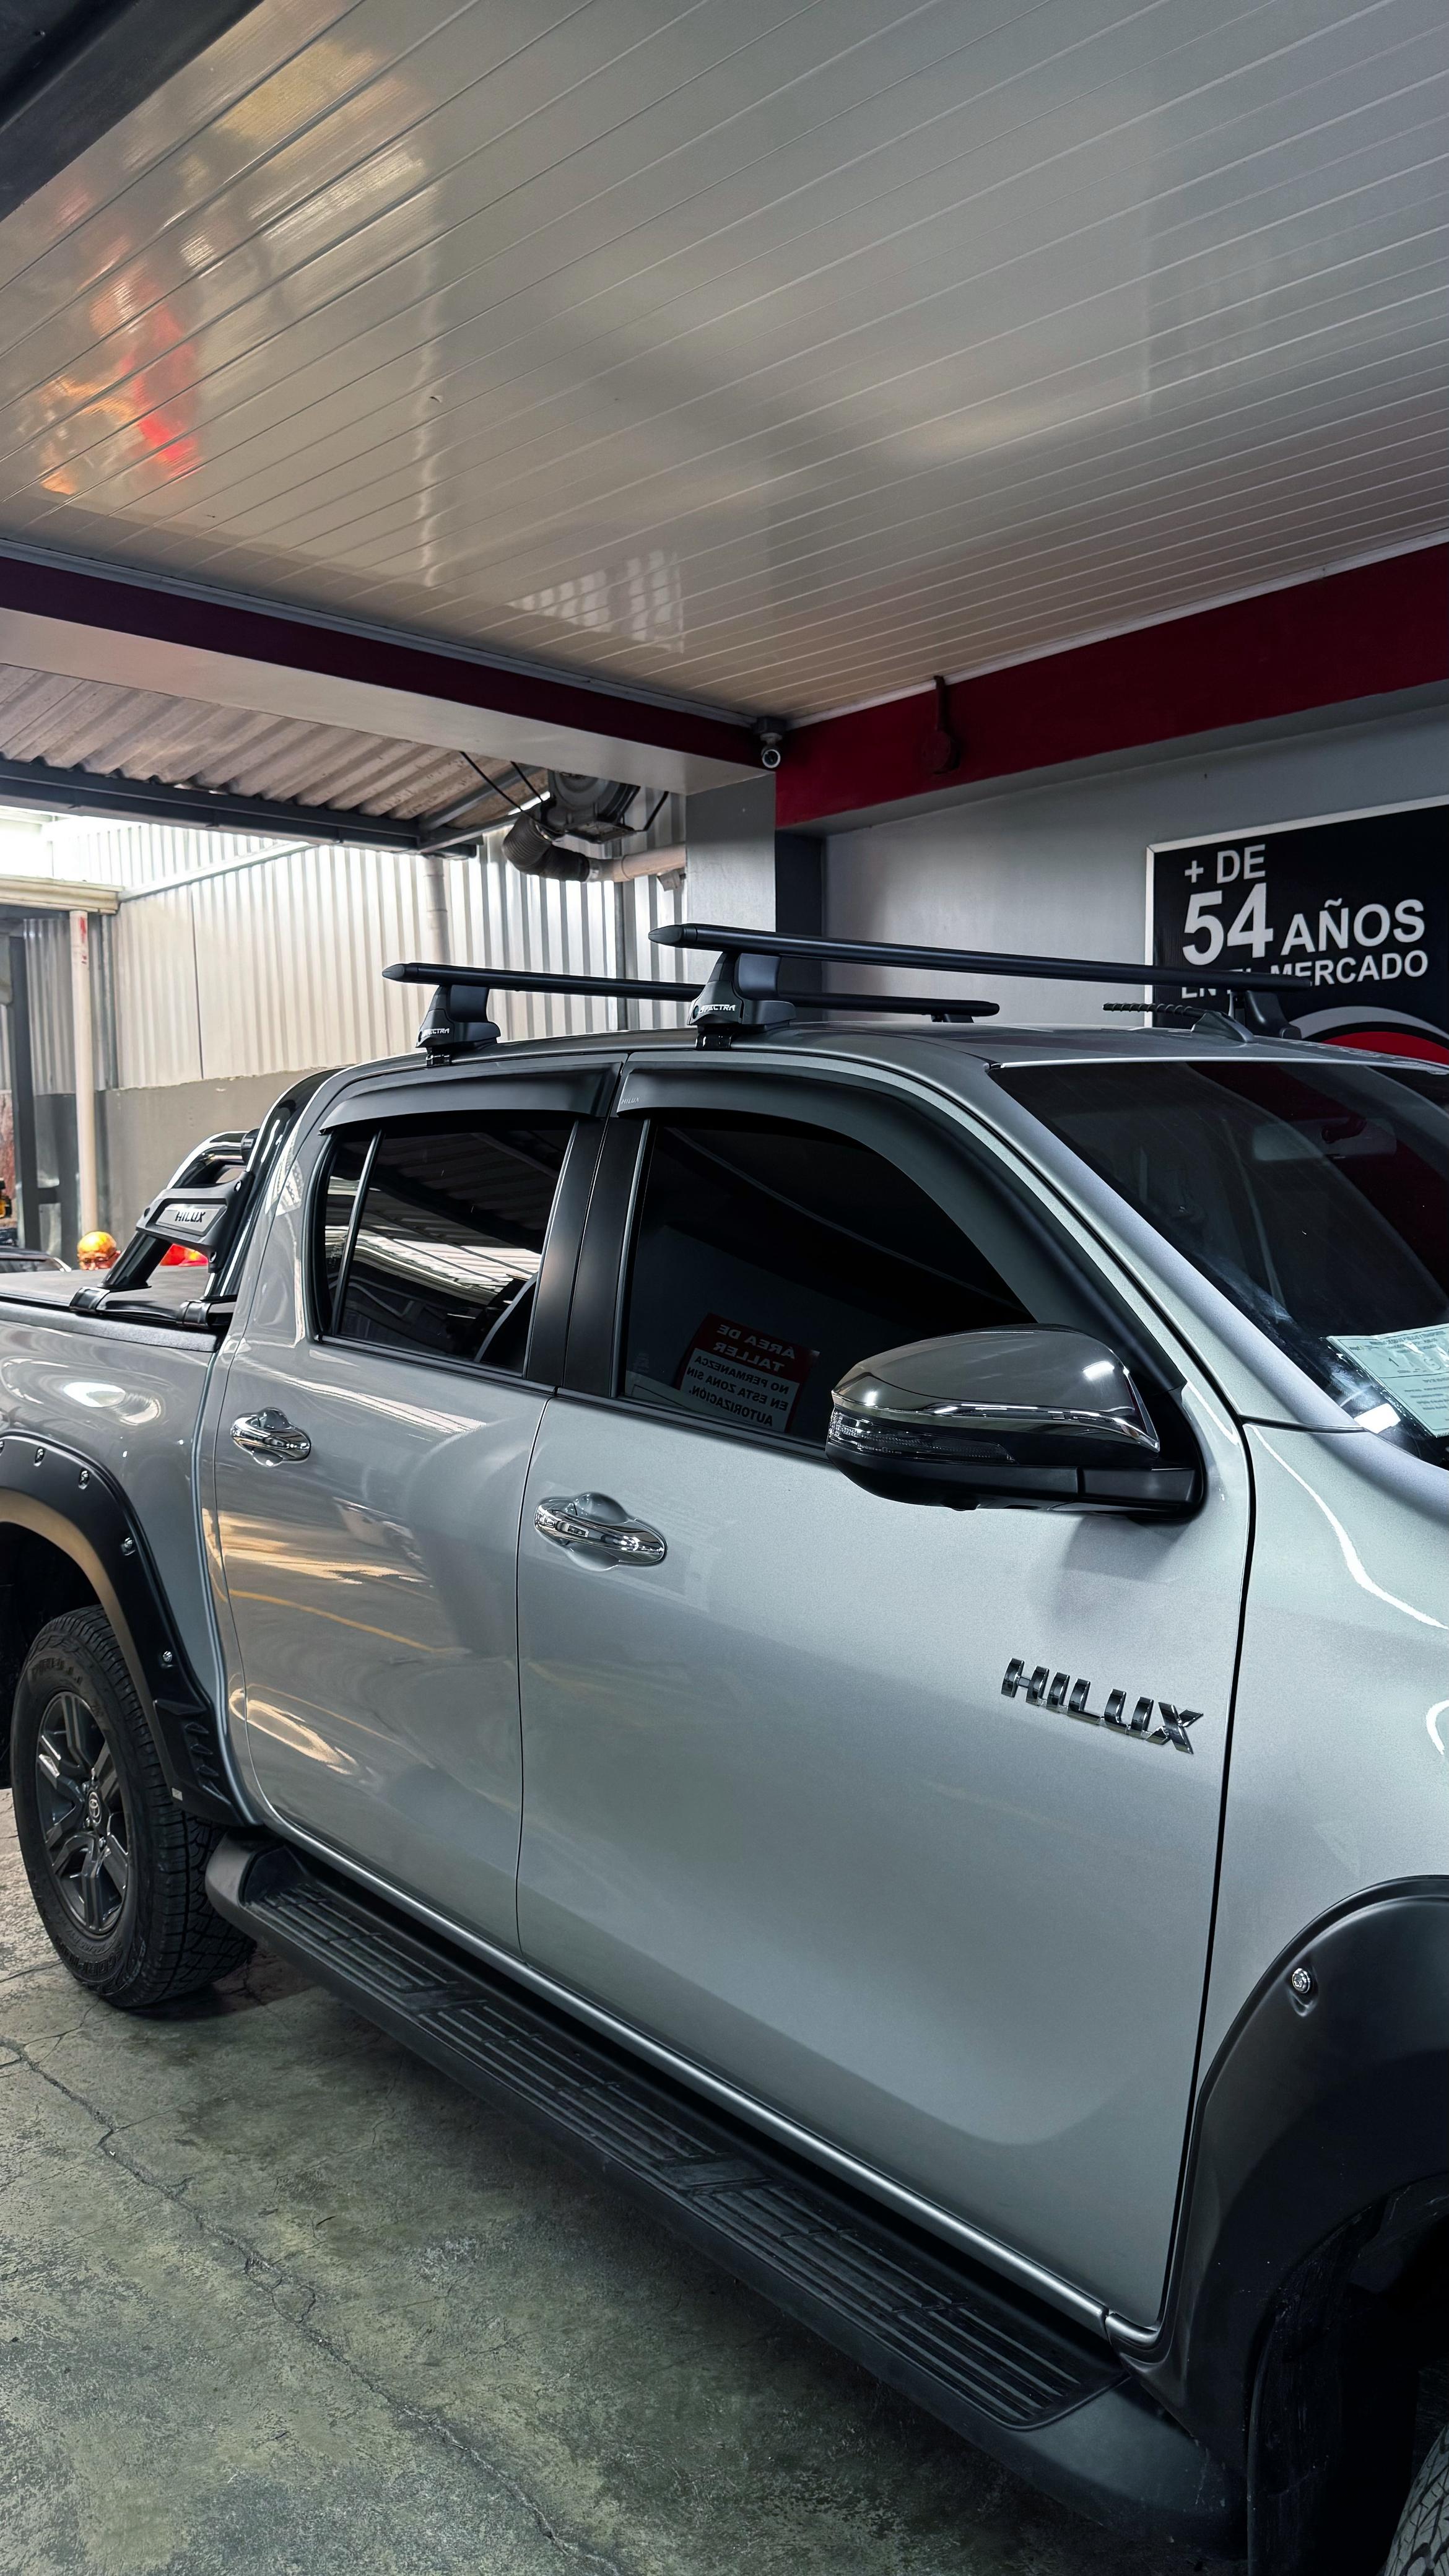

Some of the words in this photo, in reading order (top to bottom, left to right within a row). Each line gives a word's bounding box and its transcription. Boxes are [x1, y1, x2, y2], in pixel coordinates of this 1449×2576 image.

[1216, 844, 1266, 884] DE
[1182, 882, 1274, 966] 54
[1281, 898, 1425, 955] AÑOS
[175, 1211, 206, 1222] HILUX
[1001, 1658, 1204, 1754] HILUX
